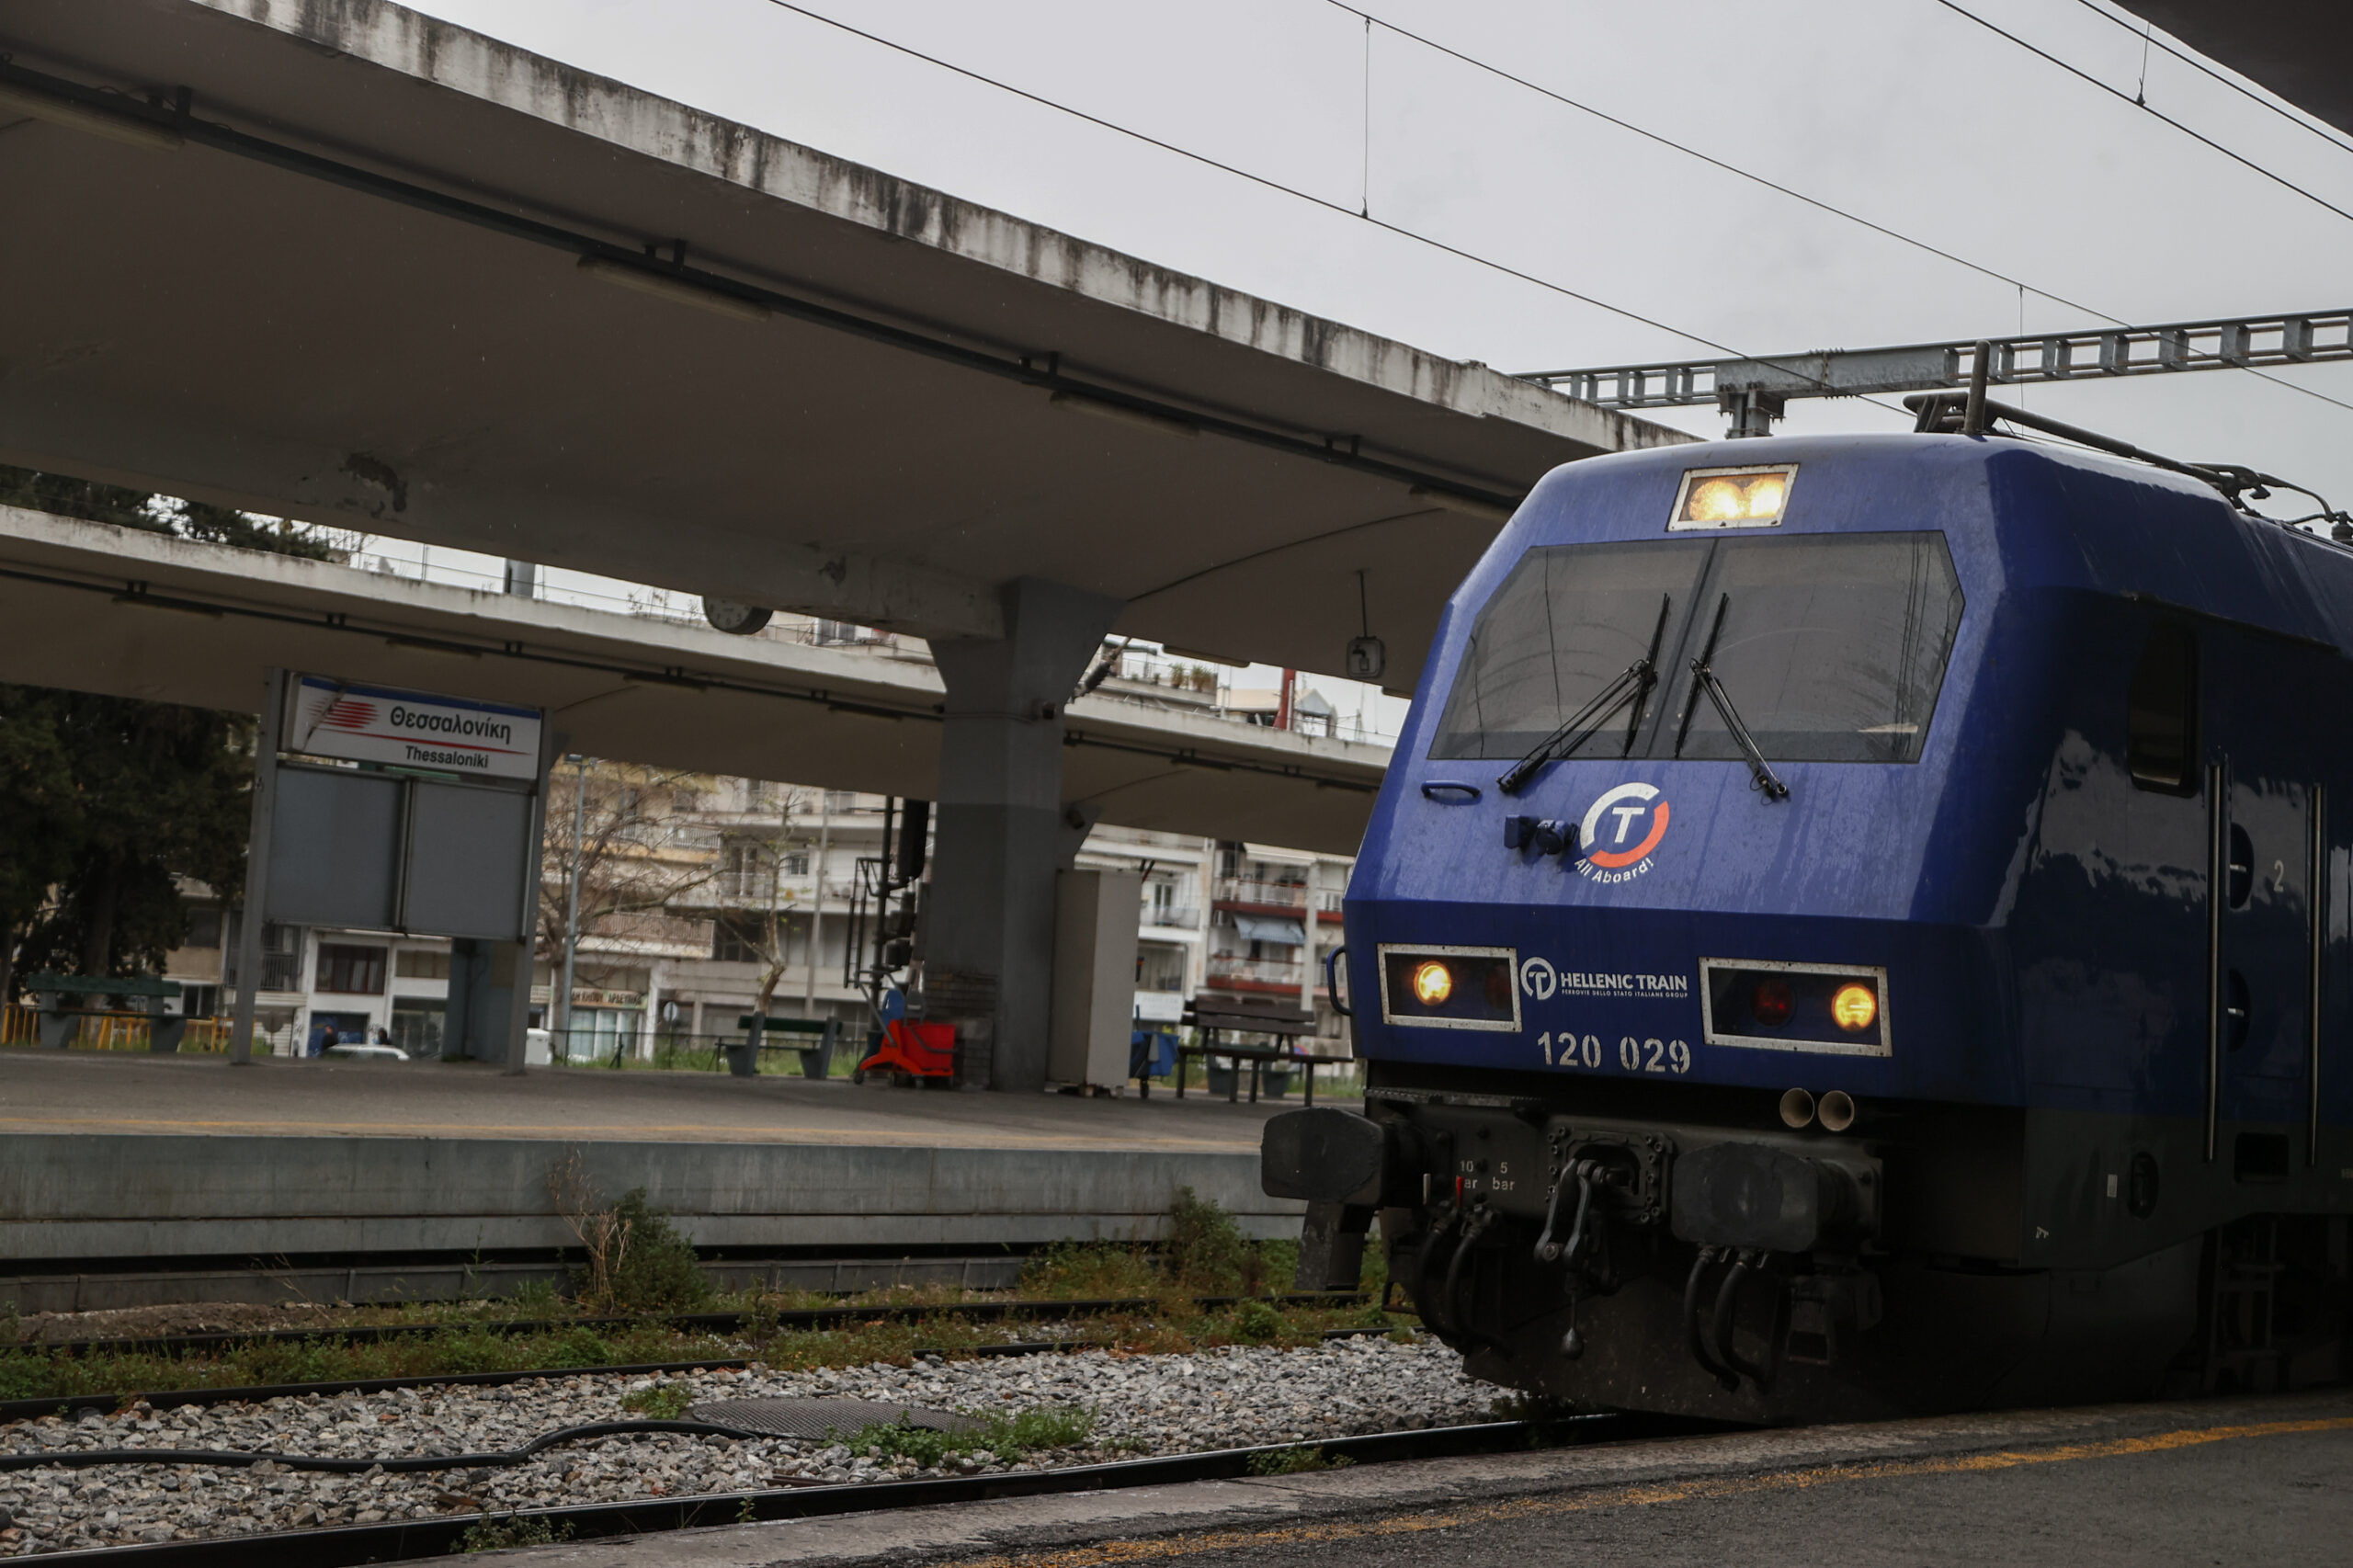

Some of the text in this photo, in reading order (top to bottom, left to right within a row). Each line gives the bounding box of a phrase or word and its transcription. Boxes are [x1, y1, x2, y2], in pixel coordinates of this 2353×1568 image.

[390, 706, 511, 744] Θεσσαλονίκη
[405, 745, 489, 768] Thessaloniki
[1574, 857, 1654, 883] All Aboard!
[2273, 859, 2284, 892] 2
[1560, 971, 1688, 991] HELLENIC TRAIN
[1561, 988, 1590, 996] FERROVIE
[1537, 1030, 1691, 1074] 120 029
[1460, 1160, 1474, 1173] 10
[1500, 1161, 1508, 1175] 5
[1457, 1176, 1478, 1189] ar
[1492, 1176, 1516, 1191] bar
